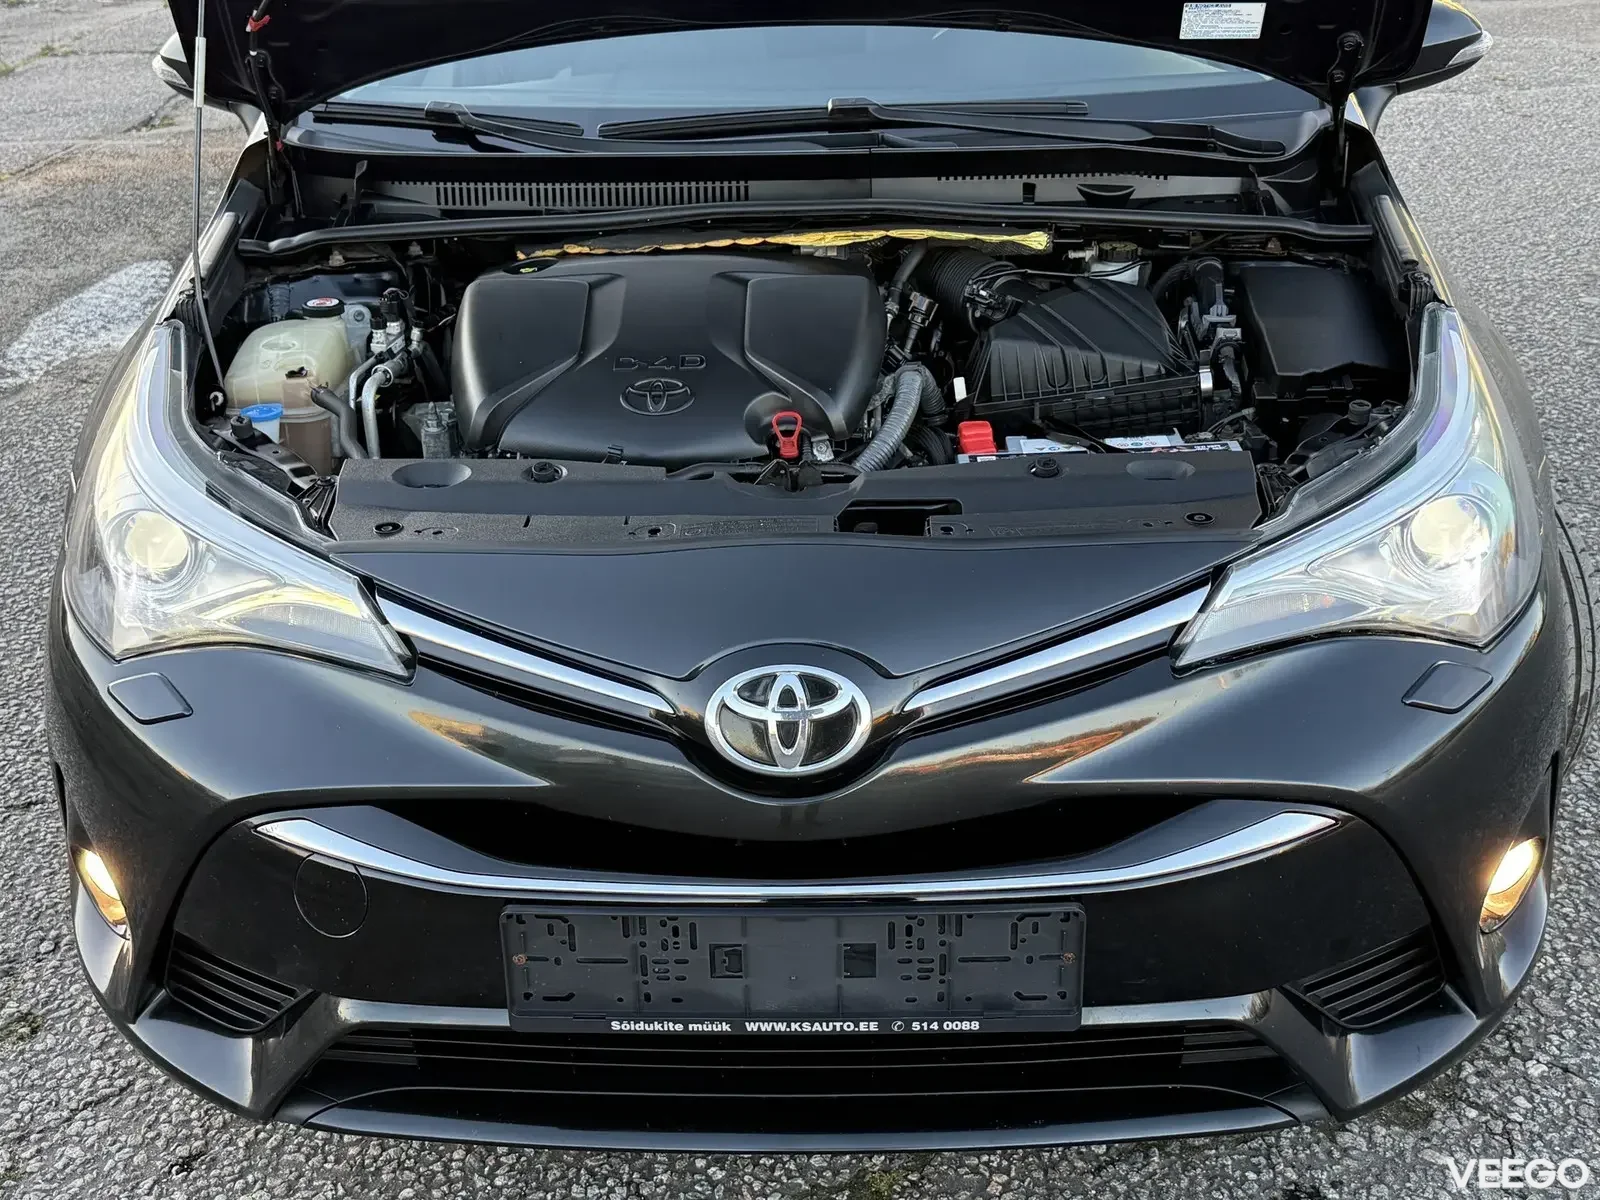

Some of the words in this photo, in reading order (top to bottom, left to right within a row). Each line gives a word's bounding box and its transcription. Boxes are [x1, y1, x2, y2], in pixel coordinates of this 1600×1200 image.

[612, 354, 707, 372] D-4D
[610, 1020, 684, 1031] Sõidukite
[688, 1021, 732, 1031] müük
[744, 1021, 879, 1032] WWW.KSAUTO.EE
[911, 1021, 939, 1031] 514
[943, 1021, 980, 1031] 0088
